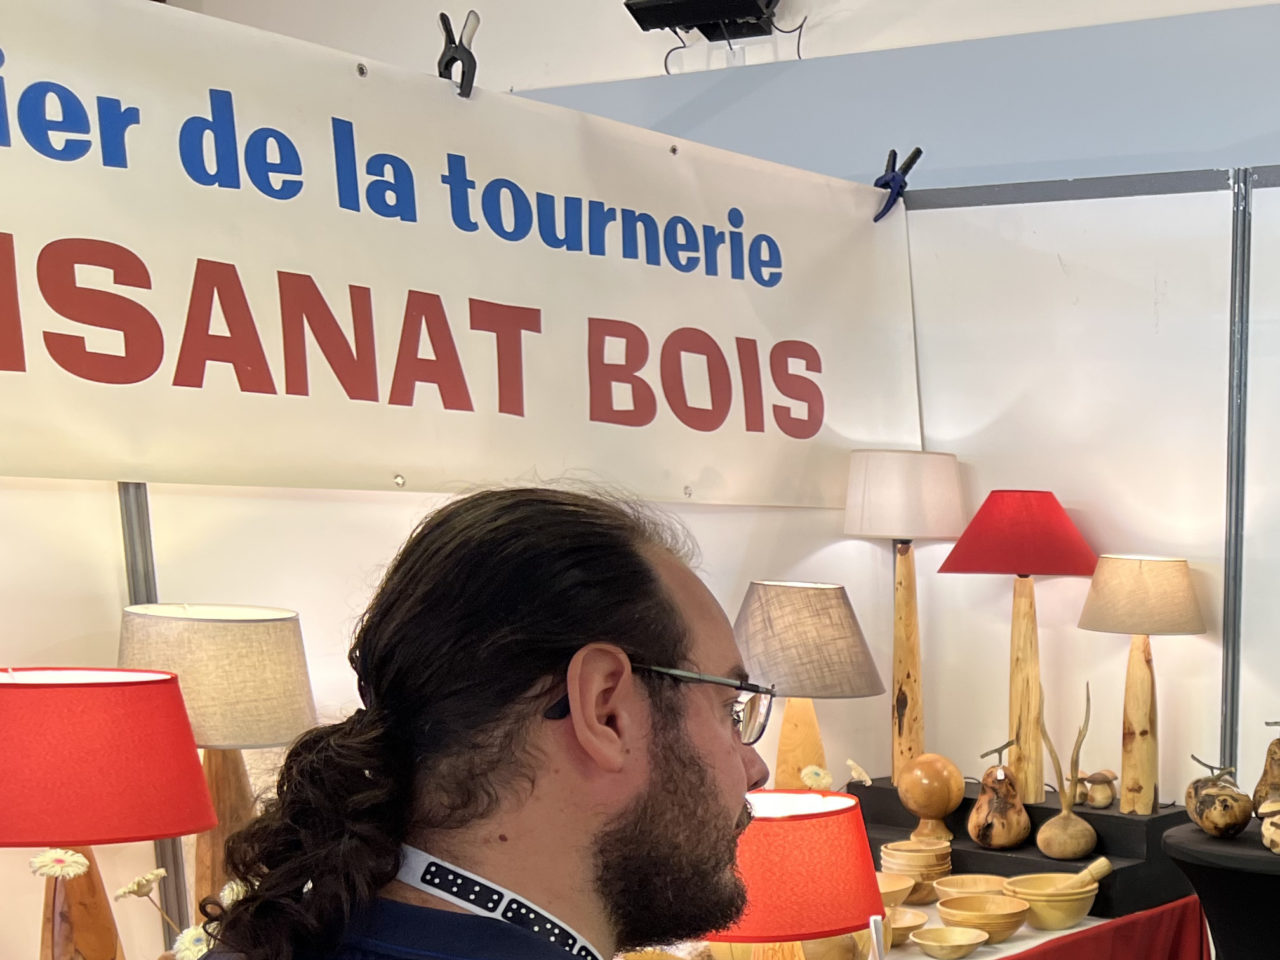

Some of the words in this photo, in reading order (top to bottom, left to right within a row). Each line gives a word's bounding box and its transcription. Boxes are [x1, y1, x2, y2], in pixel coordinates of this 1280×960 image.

[178, 88, 304, 201] de
[331, 116, 418, 223] la
[441, 152, 783, 289] tournerie
[587, 317, 825, 440] BOIS
